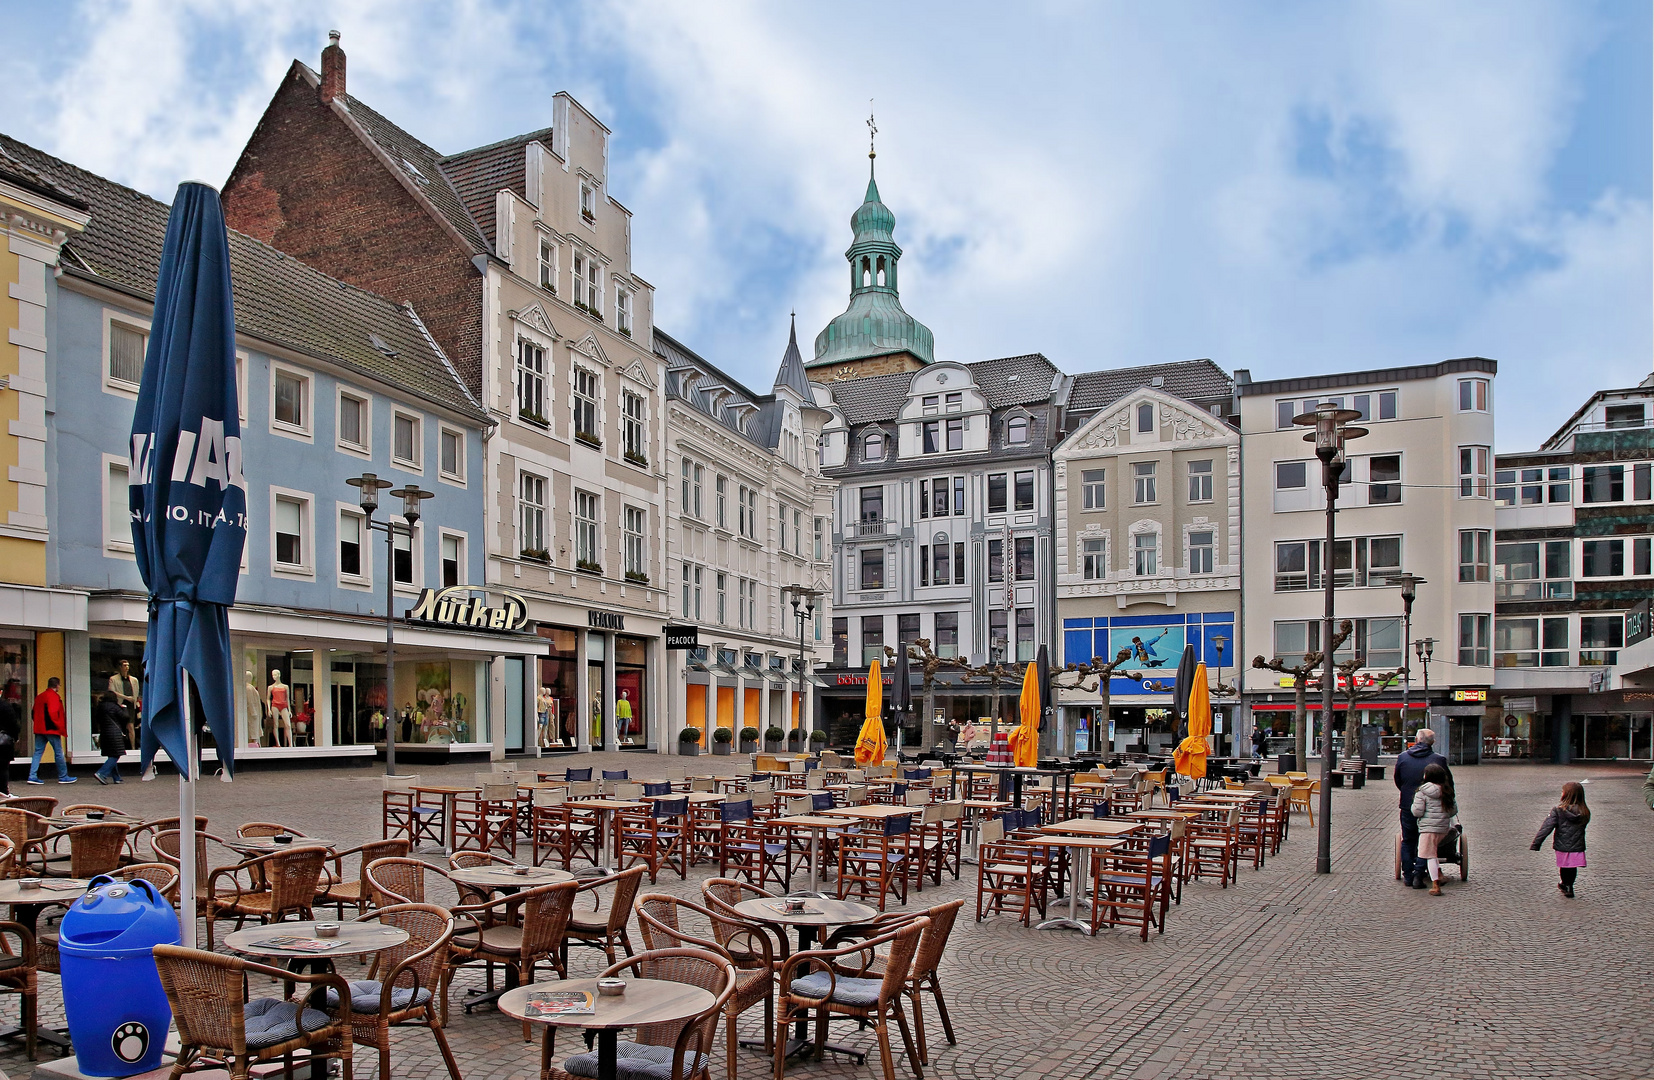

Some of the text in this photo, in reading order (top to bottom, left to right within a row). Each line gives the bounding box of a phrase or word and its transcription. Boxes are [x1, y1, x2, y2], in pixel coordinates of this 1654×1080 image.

[411, 588, 517, 630] Nückel
[588, 610, 625, 630] PEACOCK
[667, 635, 695, 645] PEACOCK
[837, 674, 867, 685] böhm
